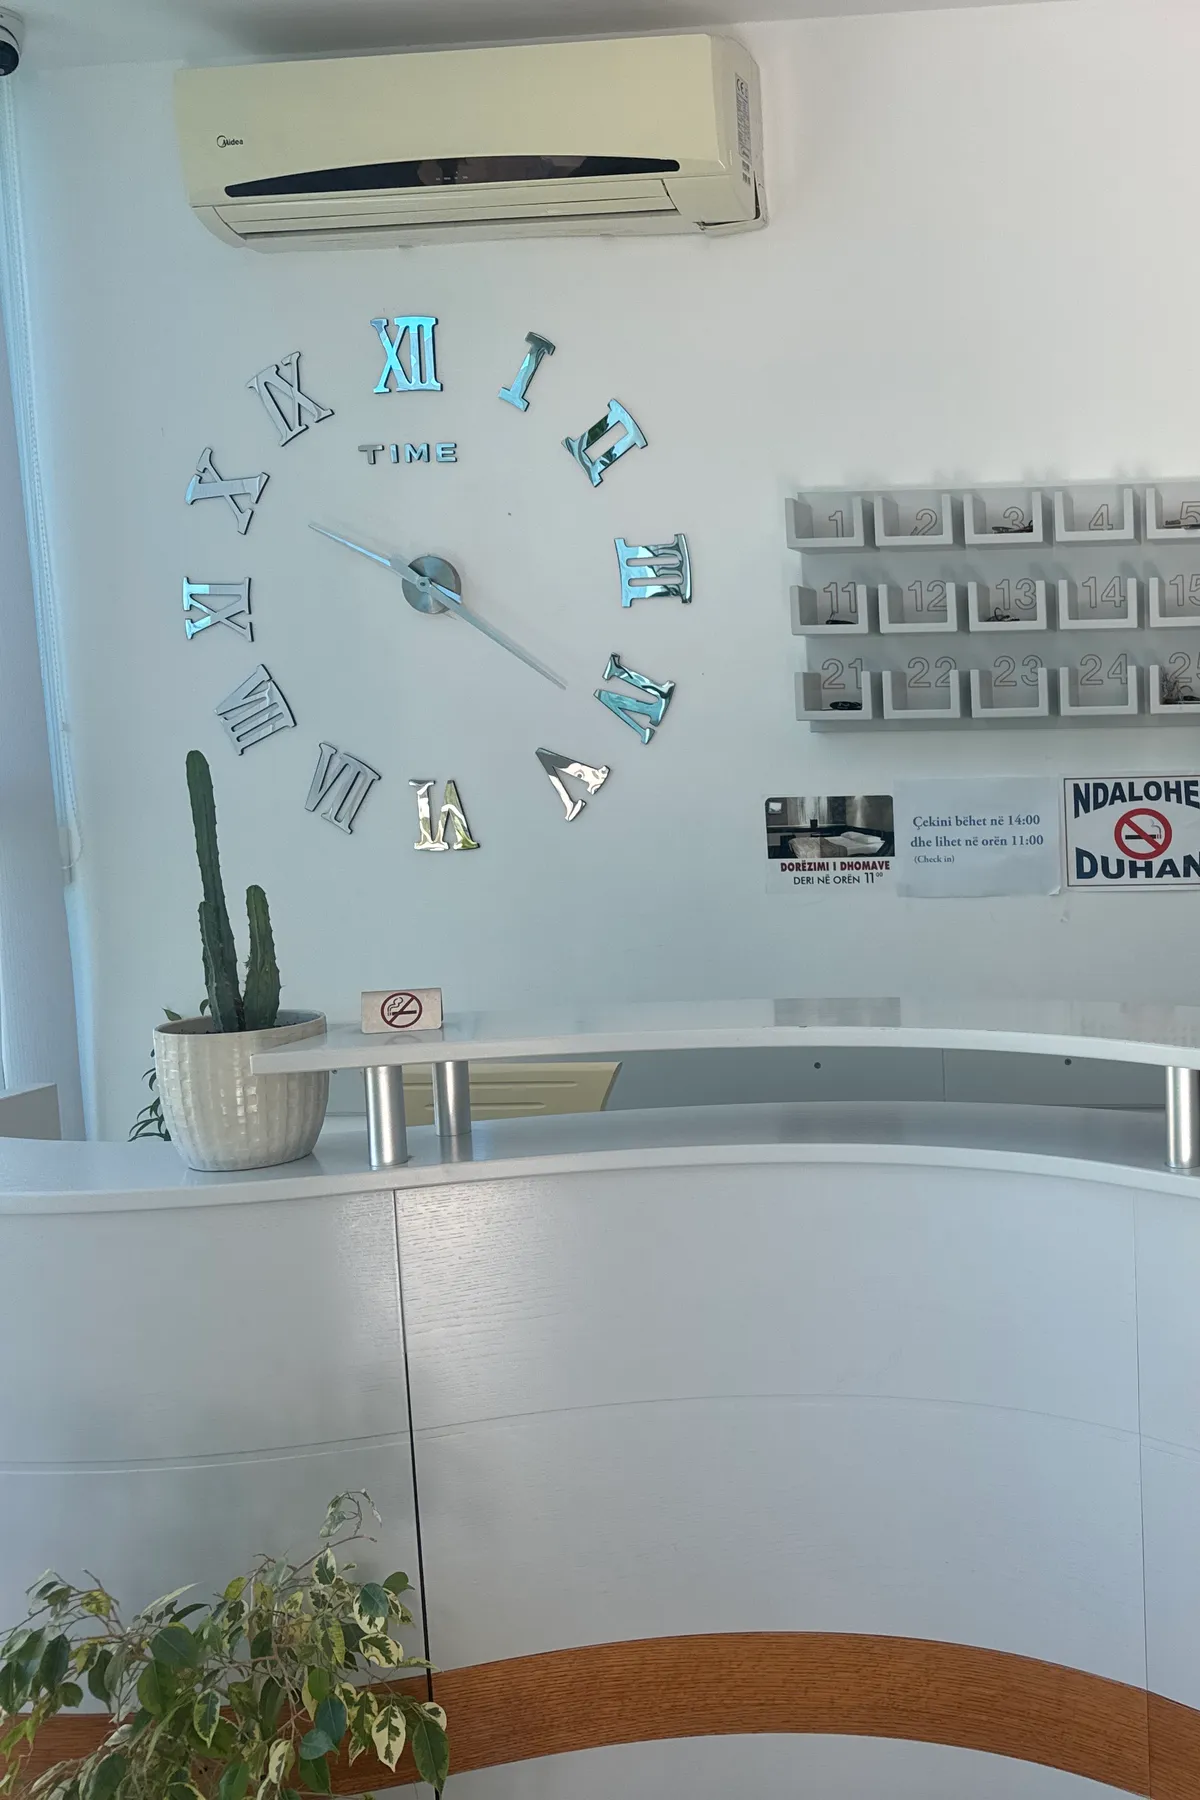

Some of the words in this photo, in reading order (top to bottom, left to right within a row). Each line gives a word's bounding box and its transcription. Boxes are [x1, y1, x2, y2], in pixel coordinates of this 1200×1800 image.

[370, 315, 443, 394] XII
[498, 331, 556, 411] I
[357, 441, 459, 465] TIME
[561, 398, 648, 487] II
[828, 510, 844, 538] 1
[910, 508, 938, 537] 2
[1002, 506, 1028, 531] 3
[1088, 503, 1114, 531] 4
[614, 532, 693, 608] III
[822, 581, 857, 614] 11
[907, 579, 948, 612] 12
[995, 577, 1037, 611] 13
[1081, 575, 1126, 609] 14
[821, 657, 863, 690] 21
[907, 656, 957, 688] 22
[993, 654, 1043, 688] 23
[1079, 652, 1129, 686] 24
[214, 664, 297, 755] VIII
[304, 741, 381, 834] VII
[535, 747, 610, 822] V
[910, 836, 932, 847] dhe
[935, 835, 962, 847] lihet
[965, 837, 979, 847] në
[981, 836, 1008, 847] orën
[1011, 834, 1044, 846] 11:00
[912, 816, 952, 830] Çekini
[955, 815, 987, 827] bëhet
[990, 816, 1004, 826] në
[1008, 814, 1041, 826] 14:00
[780, 860, 829, 872] DORËZIMI
[833, 861, 837, 871] I
[840, 860, 890, 871] DHOMAVE
[913, 855, 942, 864] (Check
[944, 855, 955, 863] in)
[793, 876, 815, 885] DERI
[817, 874, 830, 884] NË
[833, 873, 861, 884] ORËN
